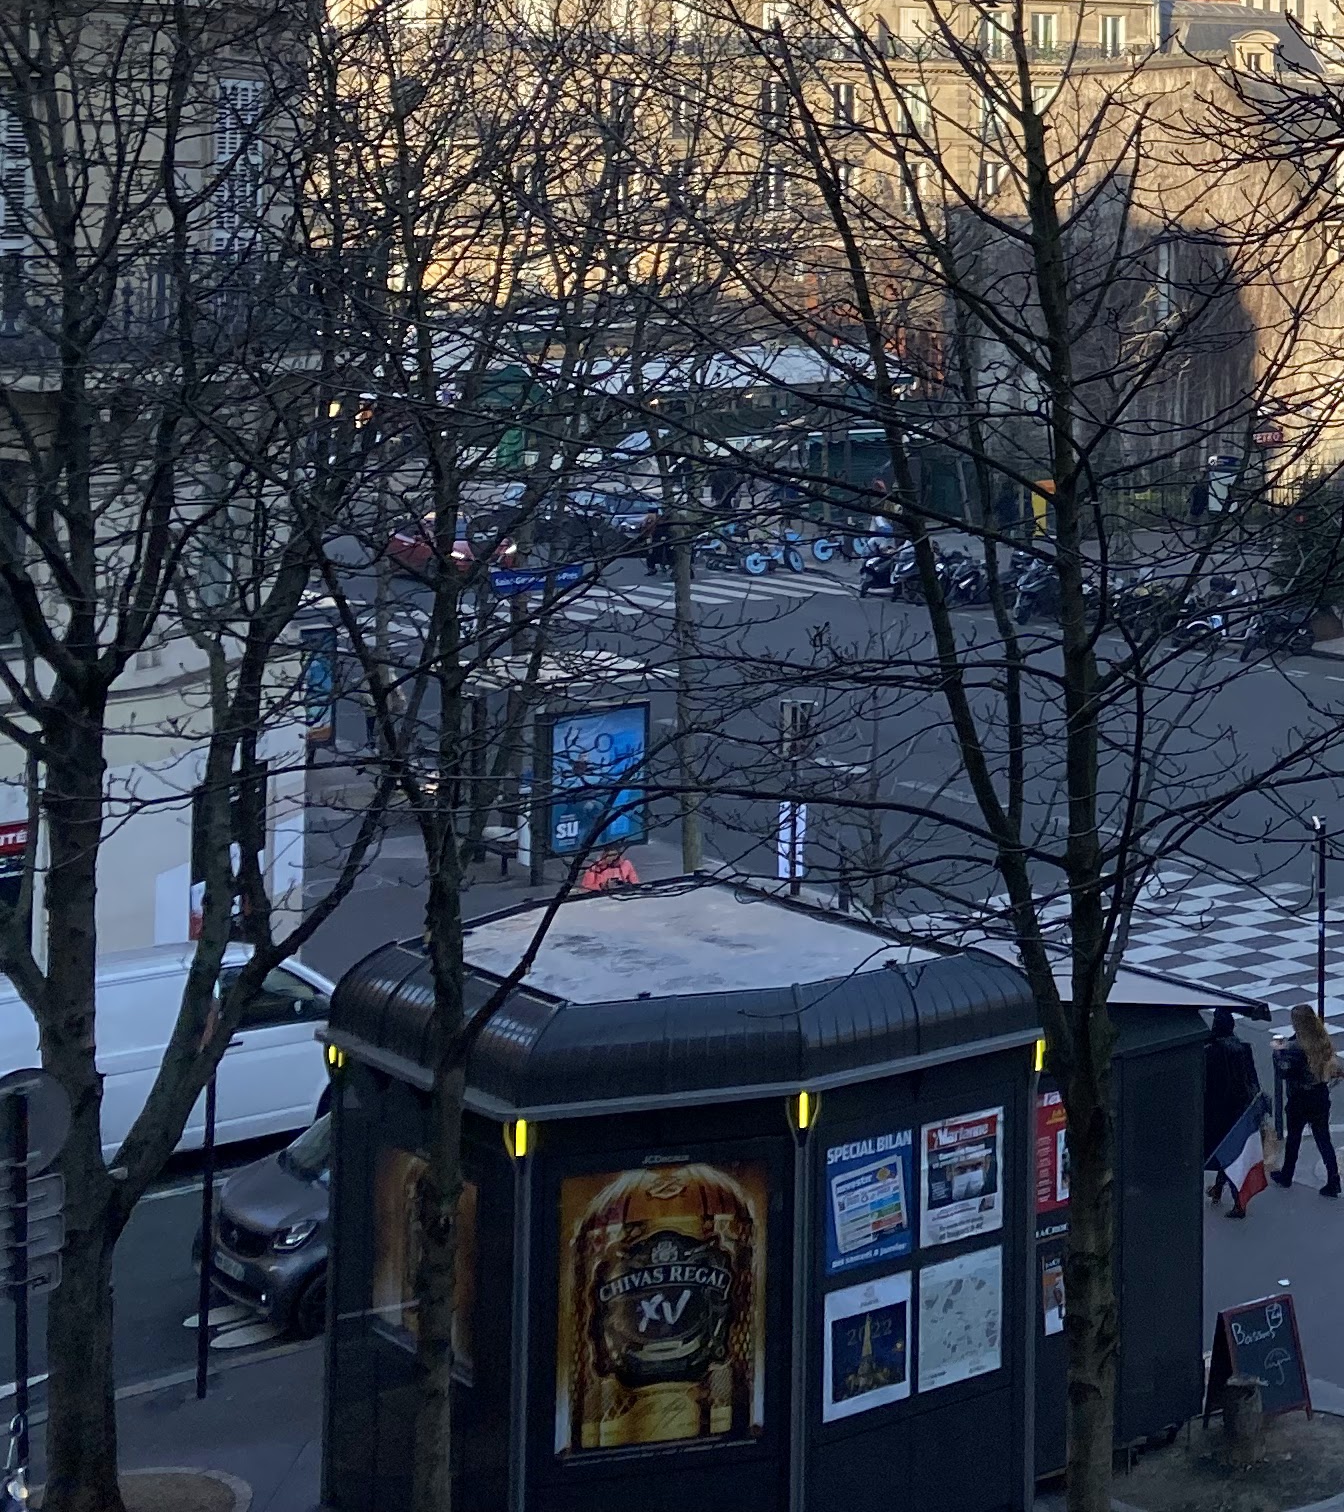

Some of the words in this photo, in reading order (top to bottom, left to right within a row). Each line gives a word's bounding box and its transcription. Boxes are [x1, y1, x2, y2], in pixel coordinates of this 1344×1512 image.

[877, 1129, 912, 1151] BILAN
[599, 1266, 665, 1303] CHIVAS
[669, 1264, 728, 1290] REGAL
[638, 1289, 692, 1333] XV
